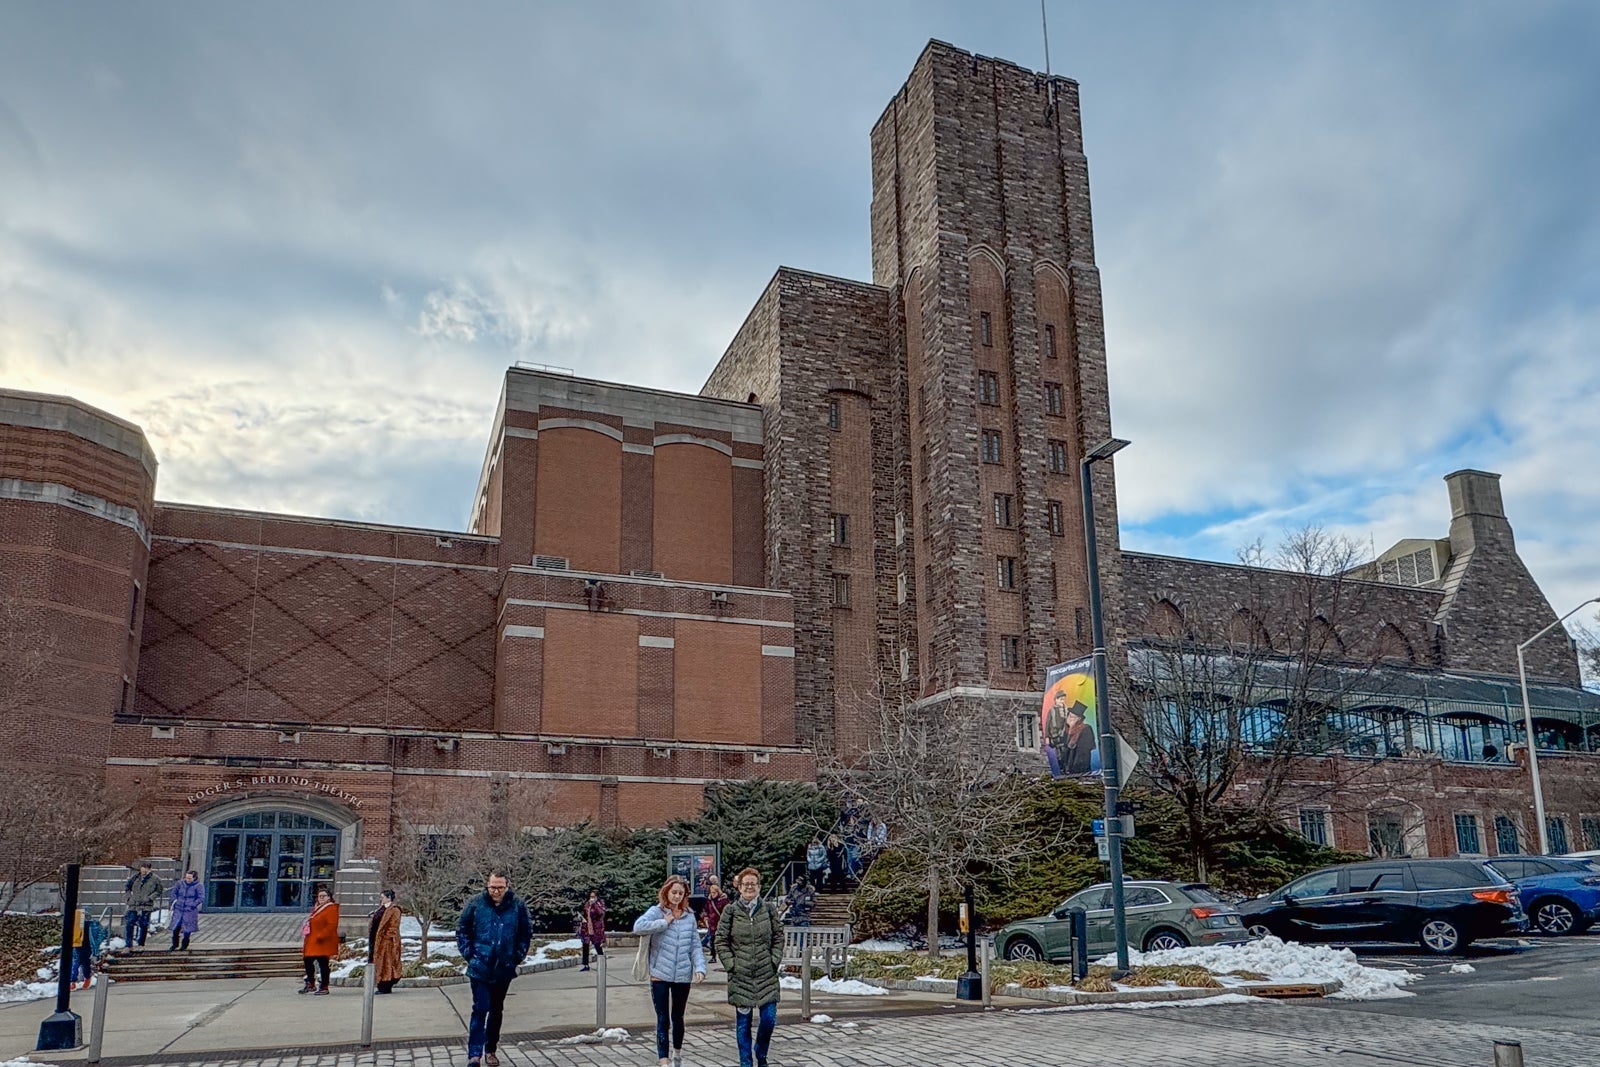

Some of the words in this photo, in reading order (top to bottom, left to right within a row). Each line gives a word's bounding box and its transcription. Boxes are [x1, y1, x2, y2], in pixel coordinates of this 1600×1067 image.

[1050, 660, 1090, 676] mccarter.org
[187, 782, 231, 804] ROGER
[236, 779, 246, 787] S.
[251, 776, 309, 786] BERLIND
[314, 781, 364, 808] THEATRE
